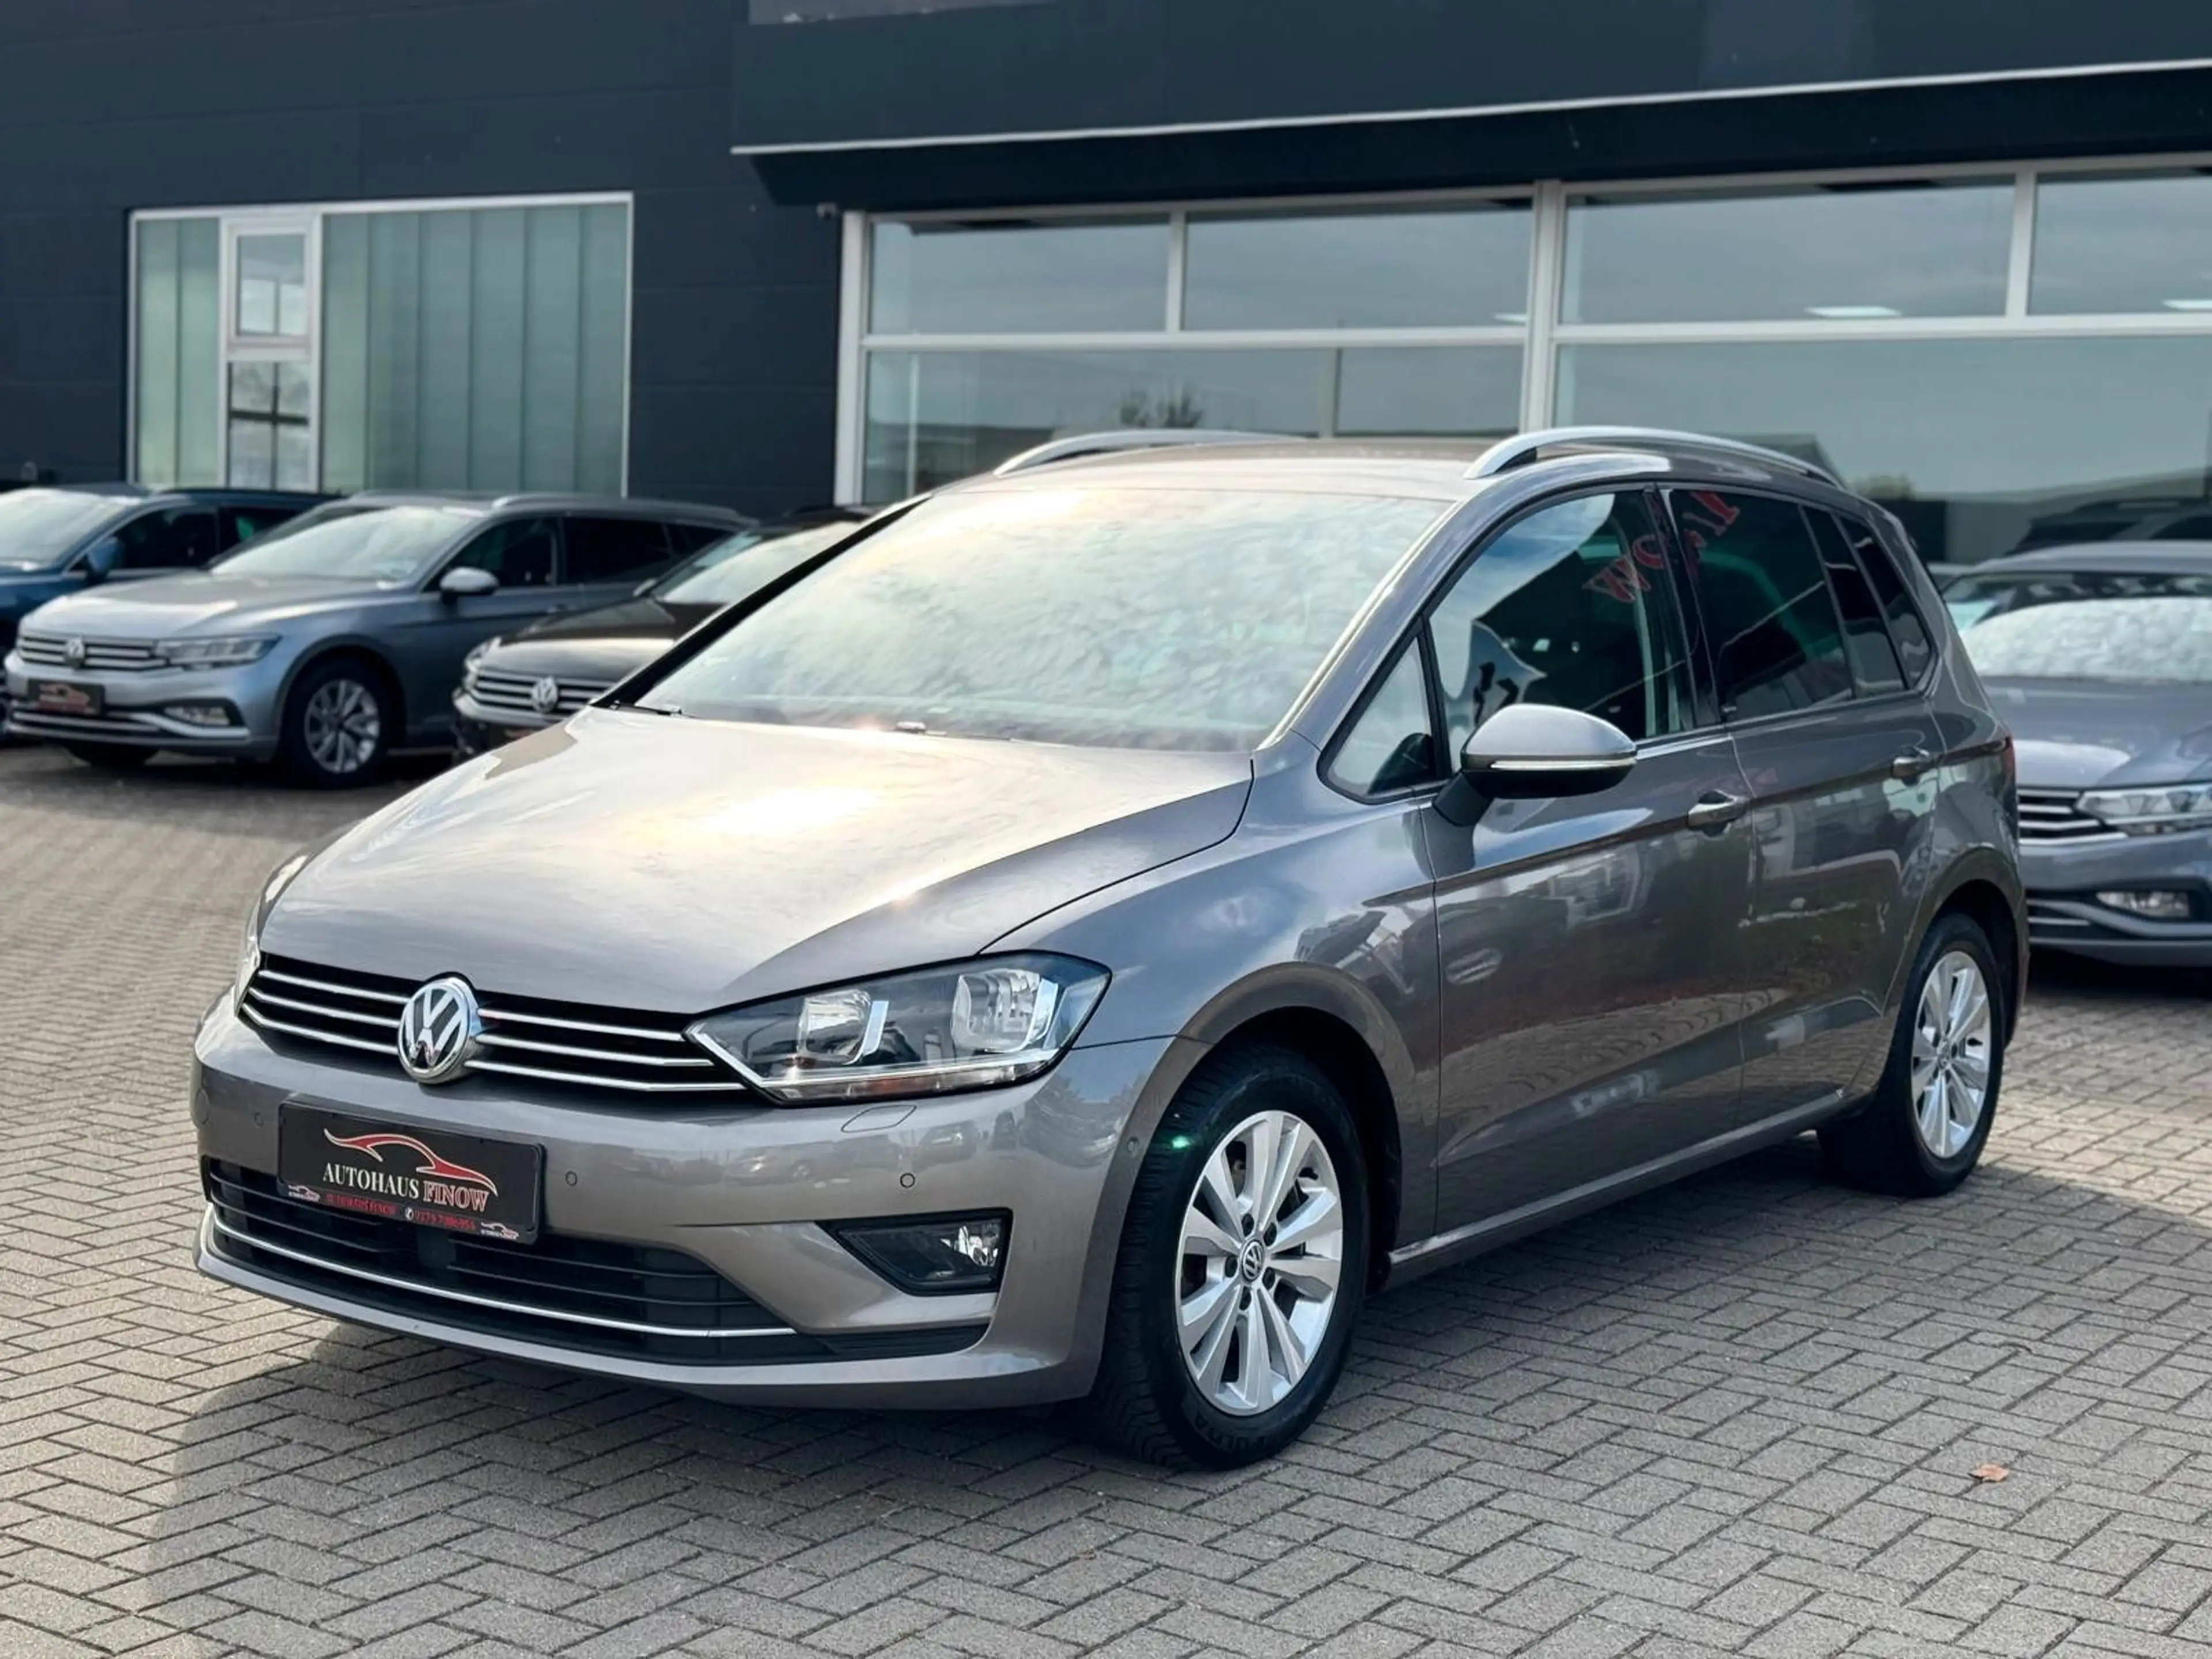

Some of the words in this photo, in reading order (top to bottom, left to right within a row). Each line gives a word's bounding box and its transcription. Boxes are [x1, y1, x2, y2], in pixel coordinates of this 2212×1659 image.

[398, 980, 471, 1081] VW
[323, 1162, 419, 1199] AUTOHAUS
[423, 1180, 489, 1212] FINOW
